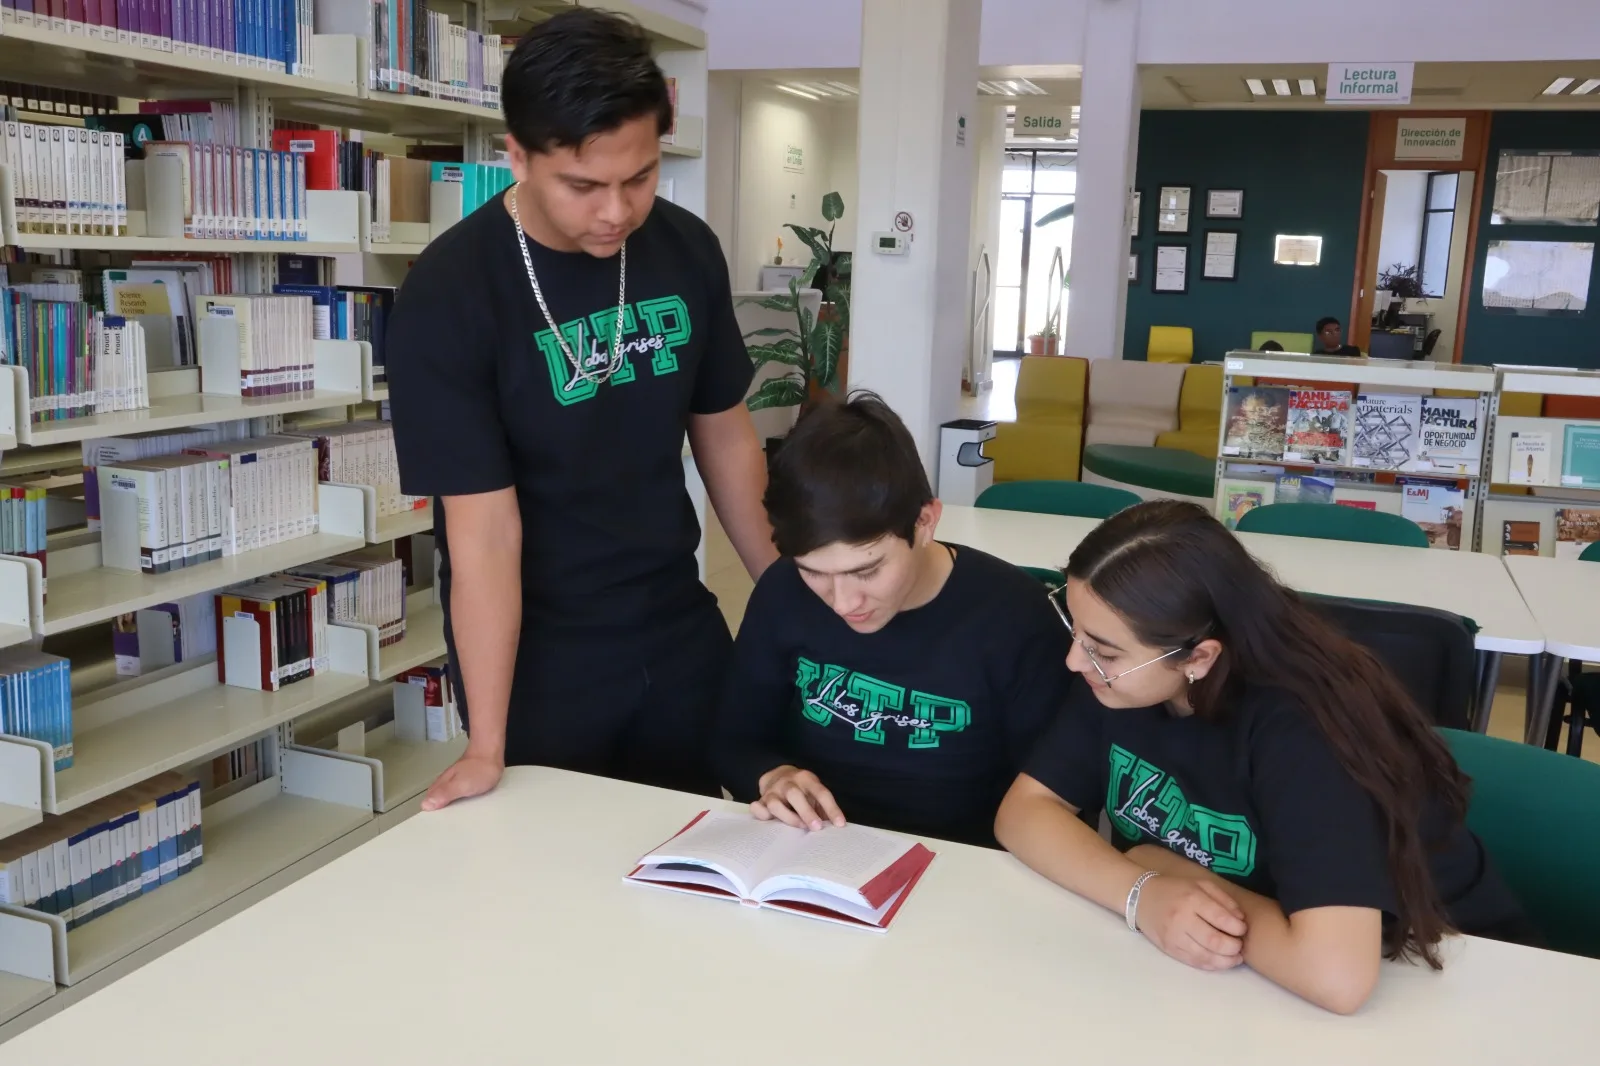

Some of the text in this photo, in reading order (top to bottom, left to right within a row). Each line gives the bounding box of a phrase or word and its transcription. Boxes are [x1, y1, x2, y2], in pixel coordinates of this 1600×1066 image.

[1344, 68, 1397, 81] Lectura
[1339, 81, 1399, 94] Informal
[1023, 116, 1062, 128] Salida
[1401, 127, 1461, 137] Dirección de
[1403, 137, 1457, 147] Innovación
[119, 291, 142, 299] Science
[533, 294, 692, 406] UTP
[1362, 404, 1413, 414] materials
[1420, 406, 1461, 419] MANU
[1420, 415, 1478, 430] FACTURA
[1424, 430, 1476, 440] OPORTUNIDAD
[1423, 438, 1467, 448] DE NEGOCIO
[1406, 487, 1430, 500] E&MJ
[796, 656, 971, 748] UTP
[855, 711, 931, 732] grises
[1115, 773, 1161, 833] Lobos
